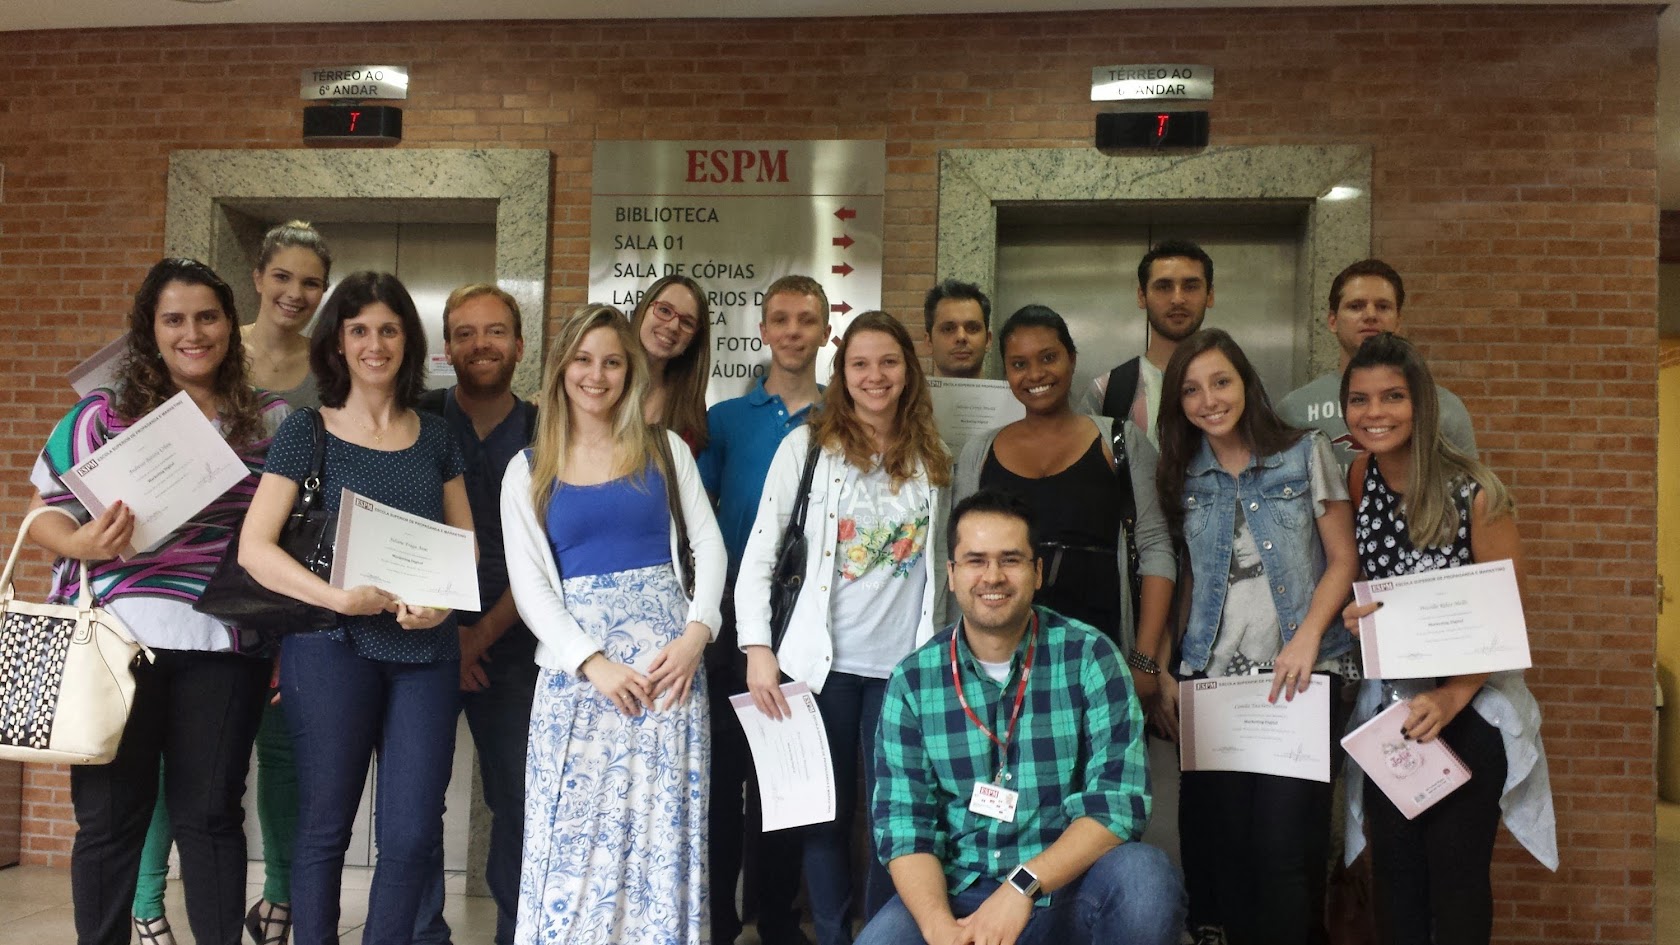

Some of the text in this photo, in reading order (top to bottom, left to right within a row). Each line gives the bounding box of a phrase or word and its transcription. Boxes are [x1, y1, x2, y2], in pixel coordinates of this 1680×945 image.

[313, 69, 384, 82] TÉRREO AO
[1109, 68, 1192, 80] TÉRREO AO
[333, 85, 378, 96] ANDAR
[1136, 85, 1185, 96] ANDAR
[350, 112, 360, 132] T
[1158, 115, 1169, 136] T
[686, 150, 789, 183] ESPM
[616, 207, 719, 222] BIBLIOTECA
[614, 235, 684, 250] SALA 01
[614, 260, 754, 279] SALA DE CÓPIAS
[717, 337, 762, 352] FOTO
[712, 361, 764, 378] ÁUDIO
[1195, 681, 1216, 690] ESPM
